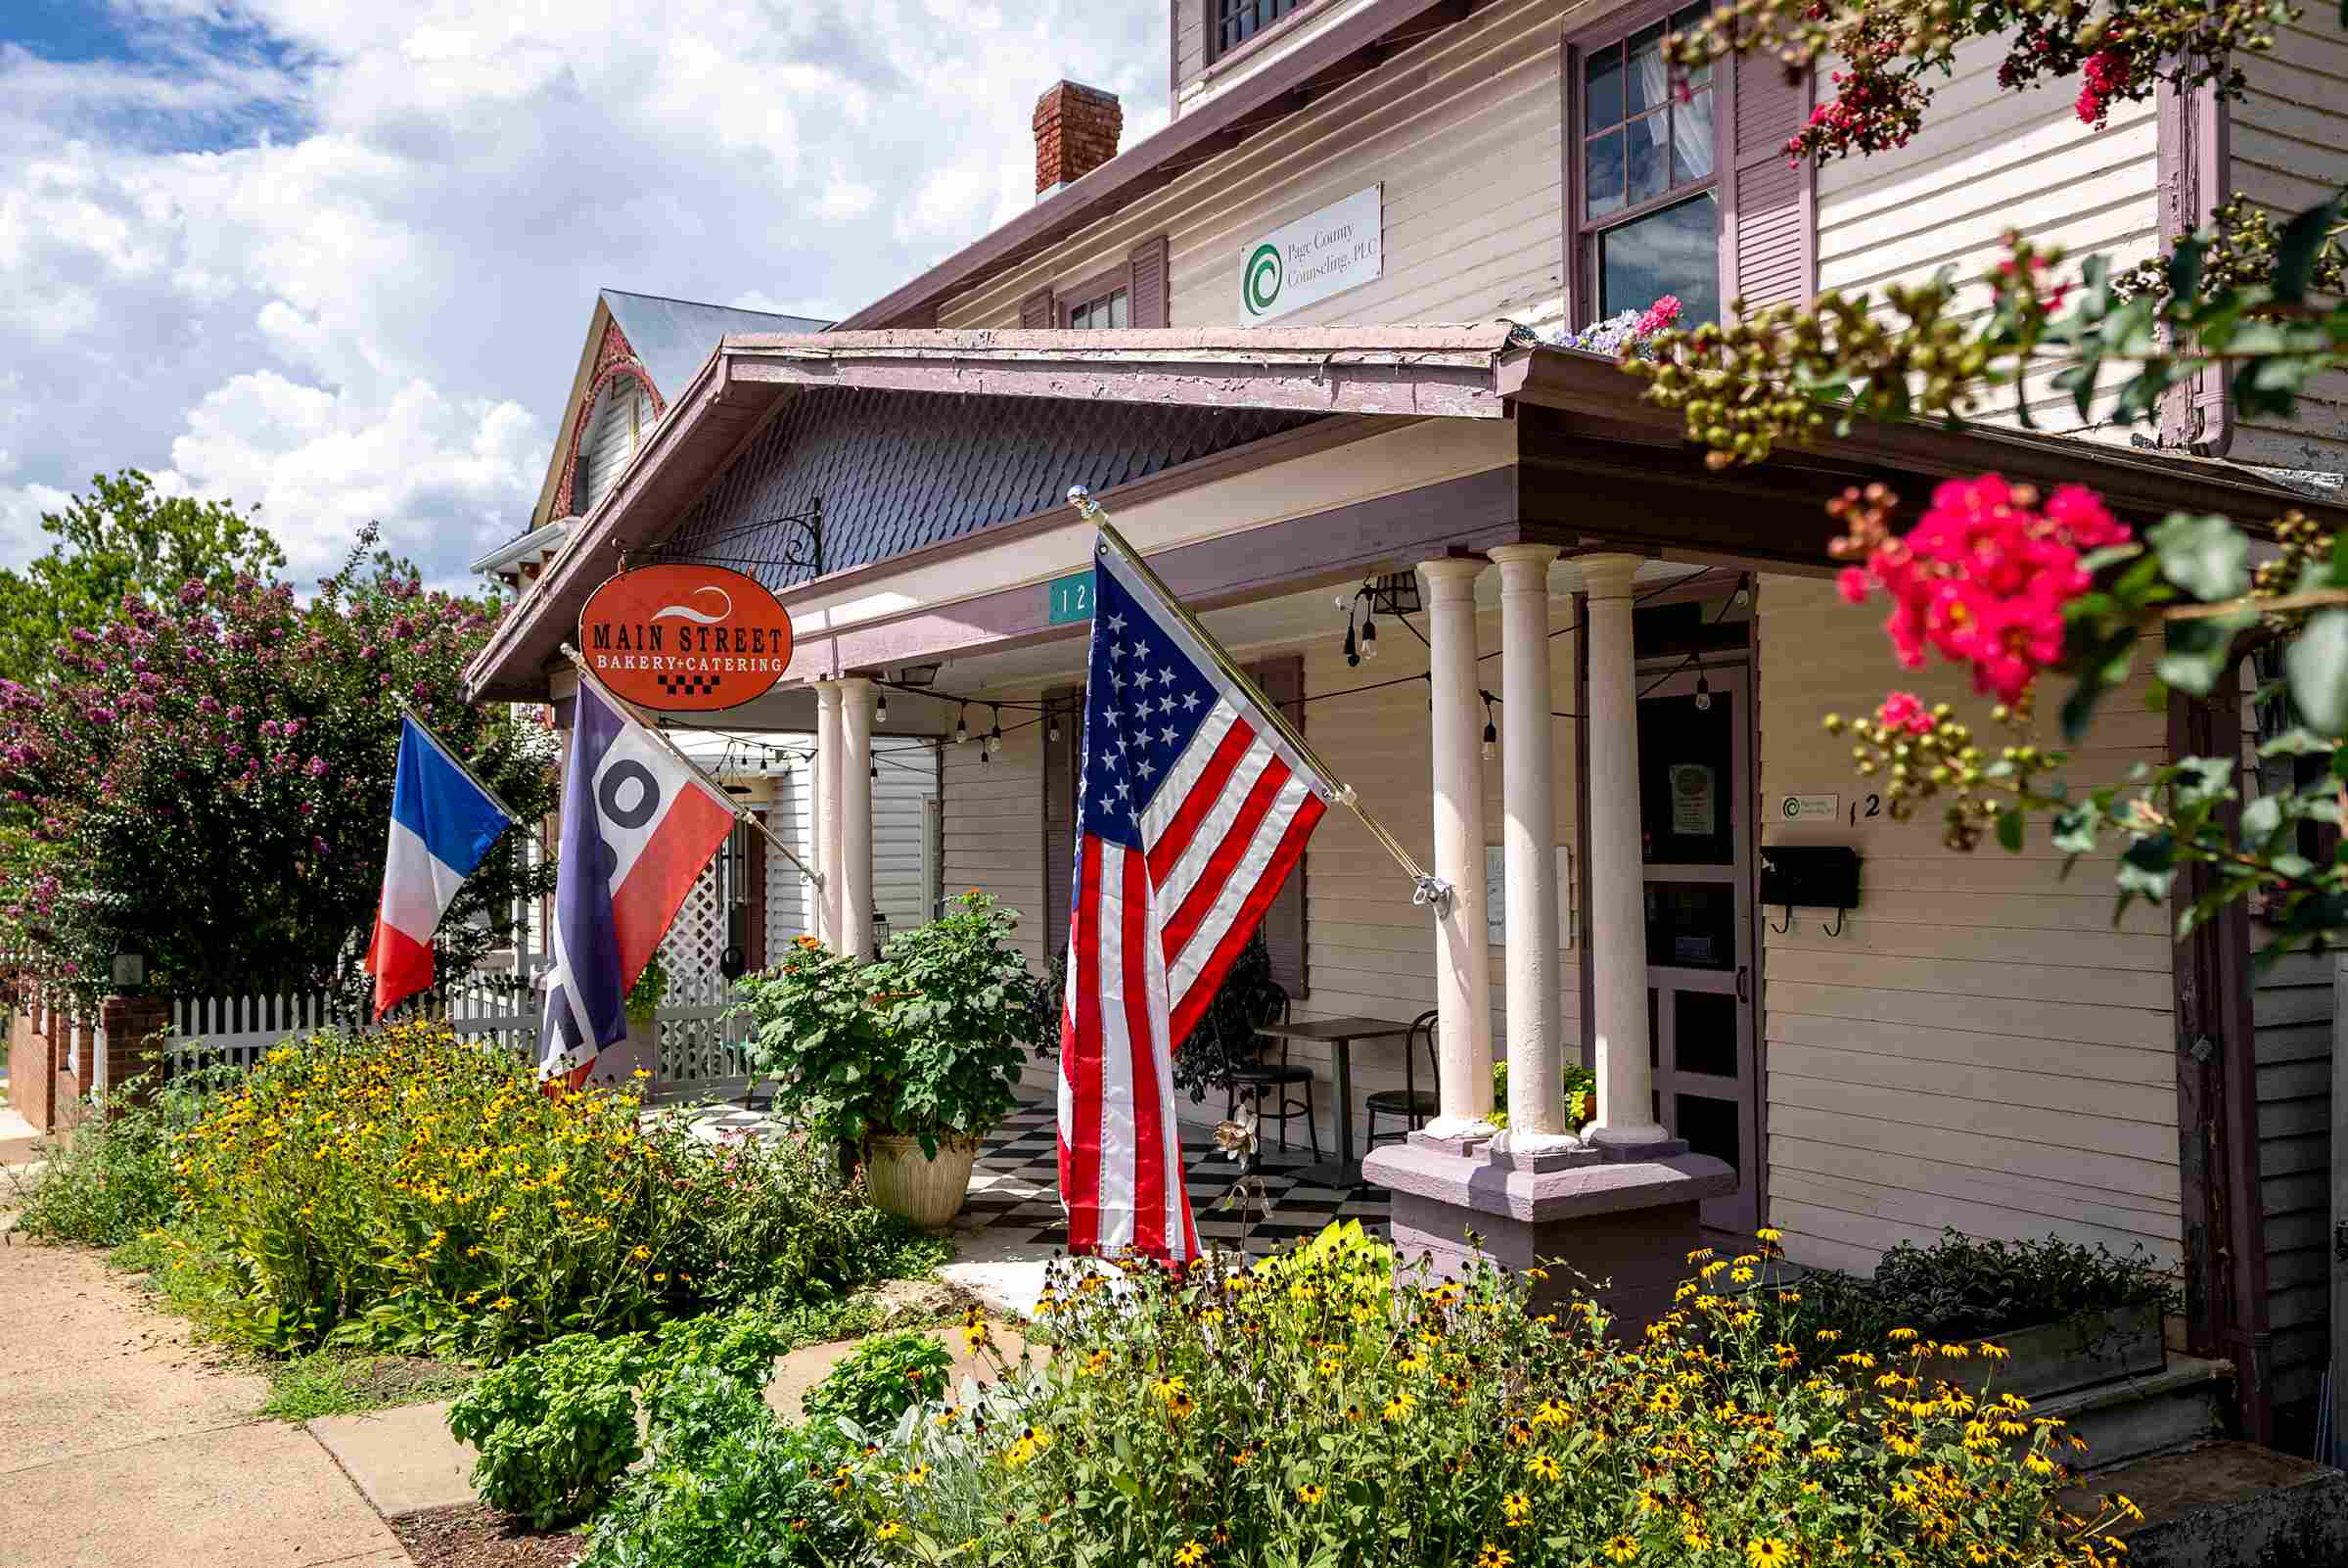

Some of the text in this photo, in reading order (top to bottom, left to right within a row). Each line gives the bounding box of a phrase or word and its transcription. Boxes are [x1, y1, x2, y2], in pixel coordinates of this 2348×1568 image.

[1286, 237, 1378, 290] Counseling, PLC
[1287, 222, 1355, 266] Page County
[593, 623, 783, 654] MAIN STREET
